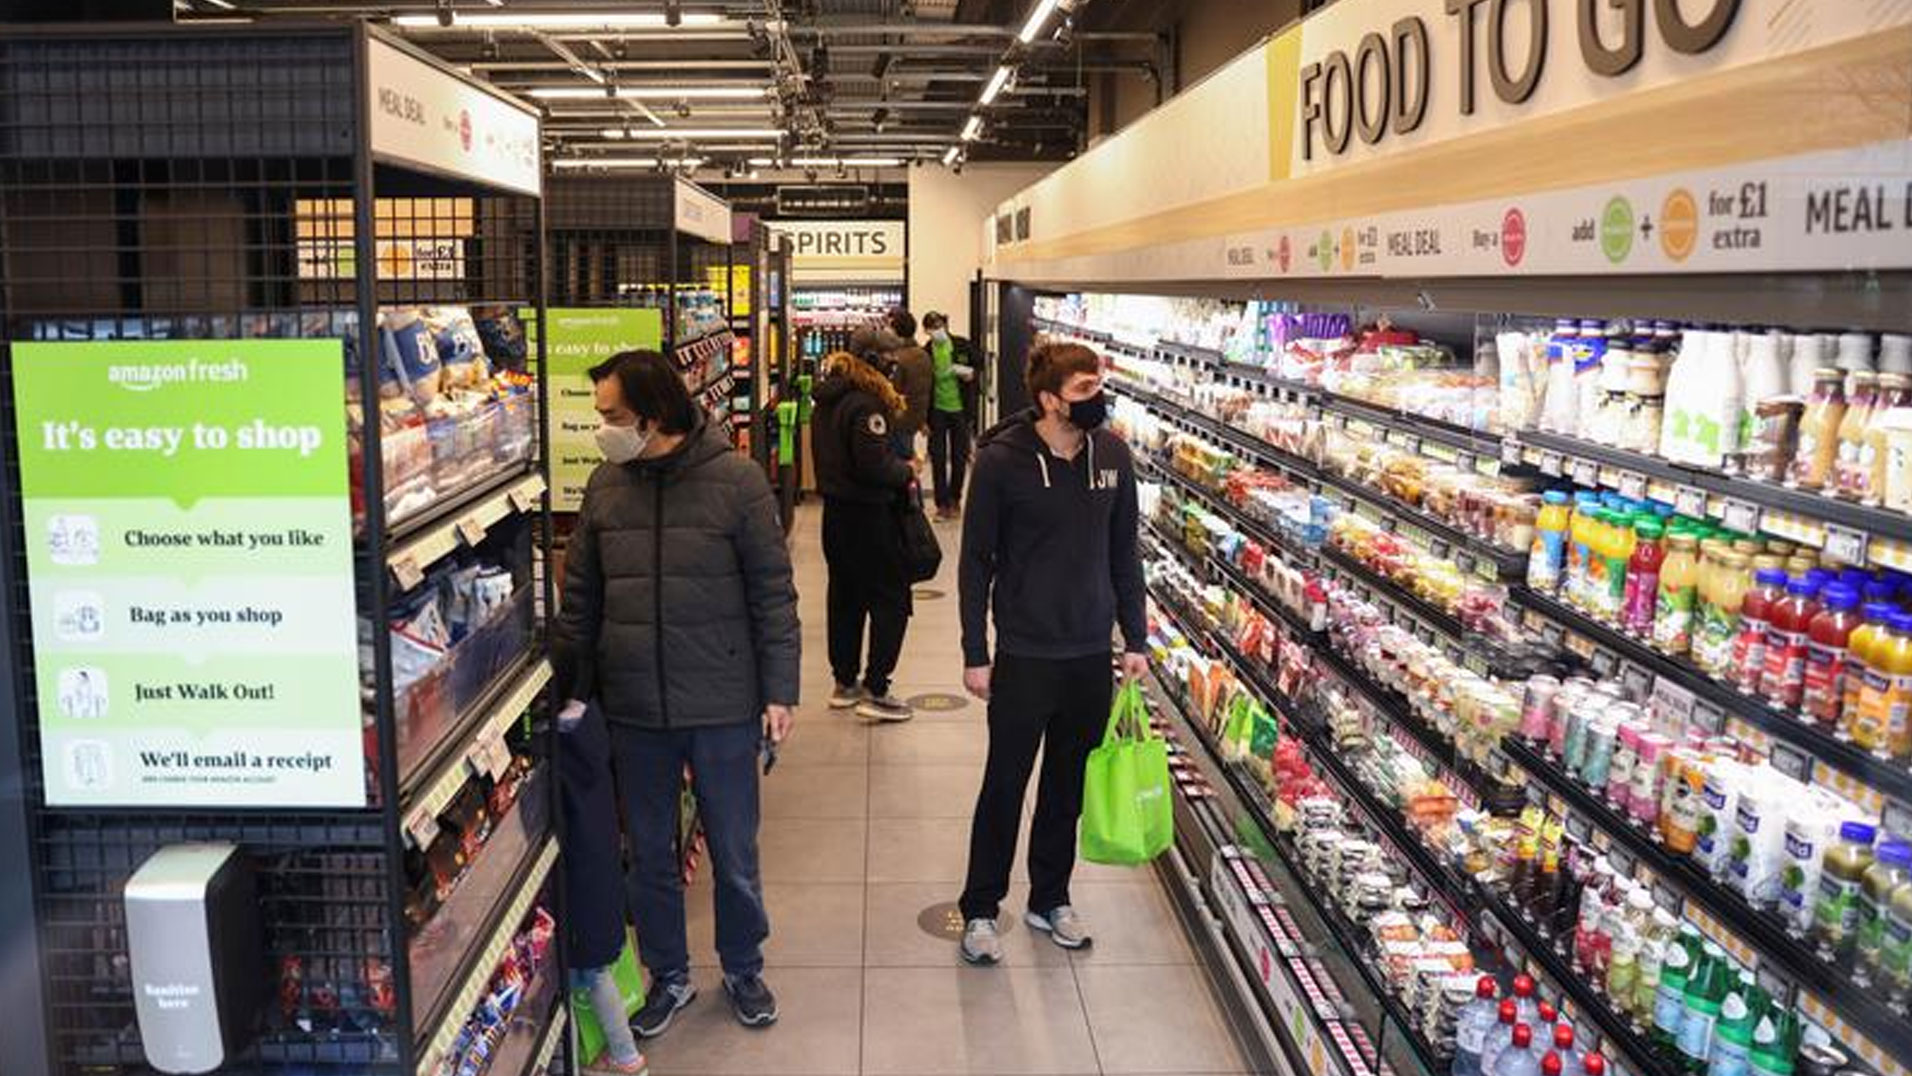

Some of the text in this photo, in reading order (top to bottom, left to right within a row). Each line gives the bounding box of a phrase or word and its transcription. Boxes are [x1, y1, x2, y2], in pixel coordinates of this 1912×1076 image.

[1300, 16, 1430, 160] FOOD
[1445, 0, 1548, 116] TO
[1709, 181, 1768, 218] for £1
[1806, 186, 1892, 234] MEAL
[1572, 217, 1595, 242] add
[1713, 226, 1761, 249] extra
[785, 231, 887, 254] SPIRITS
[108, 358, 248, 388] amazon fresh
[43, 419, 322, 456] It's easy to shop
[1097, 469, 1118, 489] JW
[124, 529, 324, 550] Choose what you like
[130, 607, 282, 626] Bag as you shop
[135, 684, 274, 703] Just Walk Out!
[140, 751, 332, 772] We'll email a receipt
